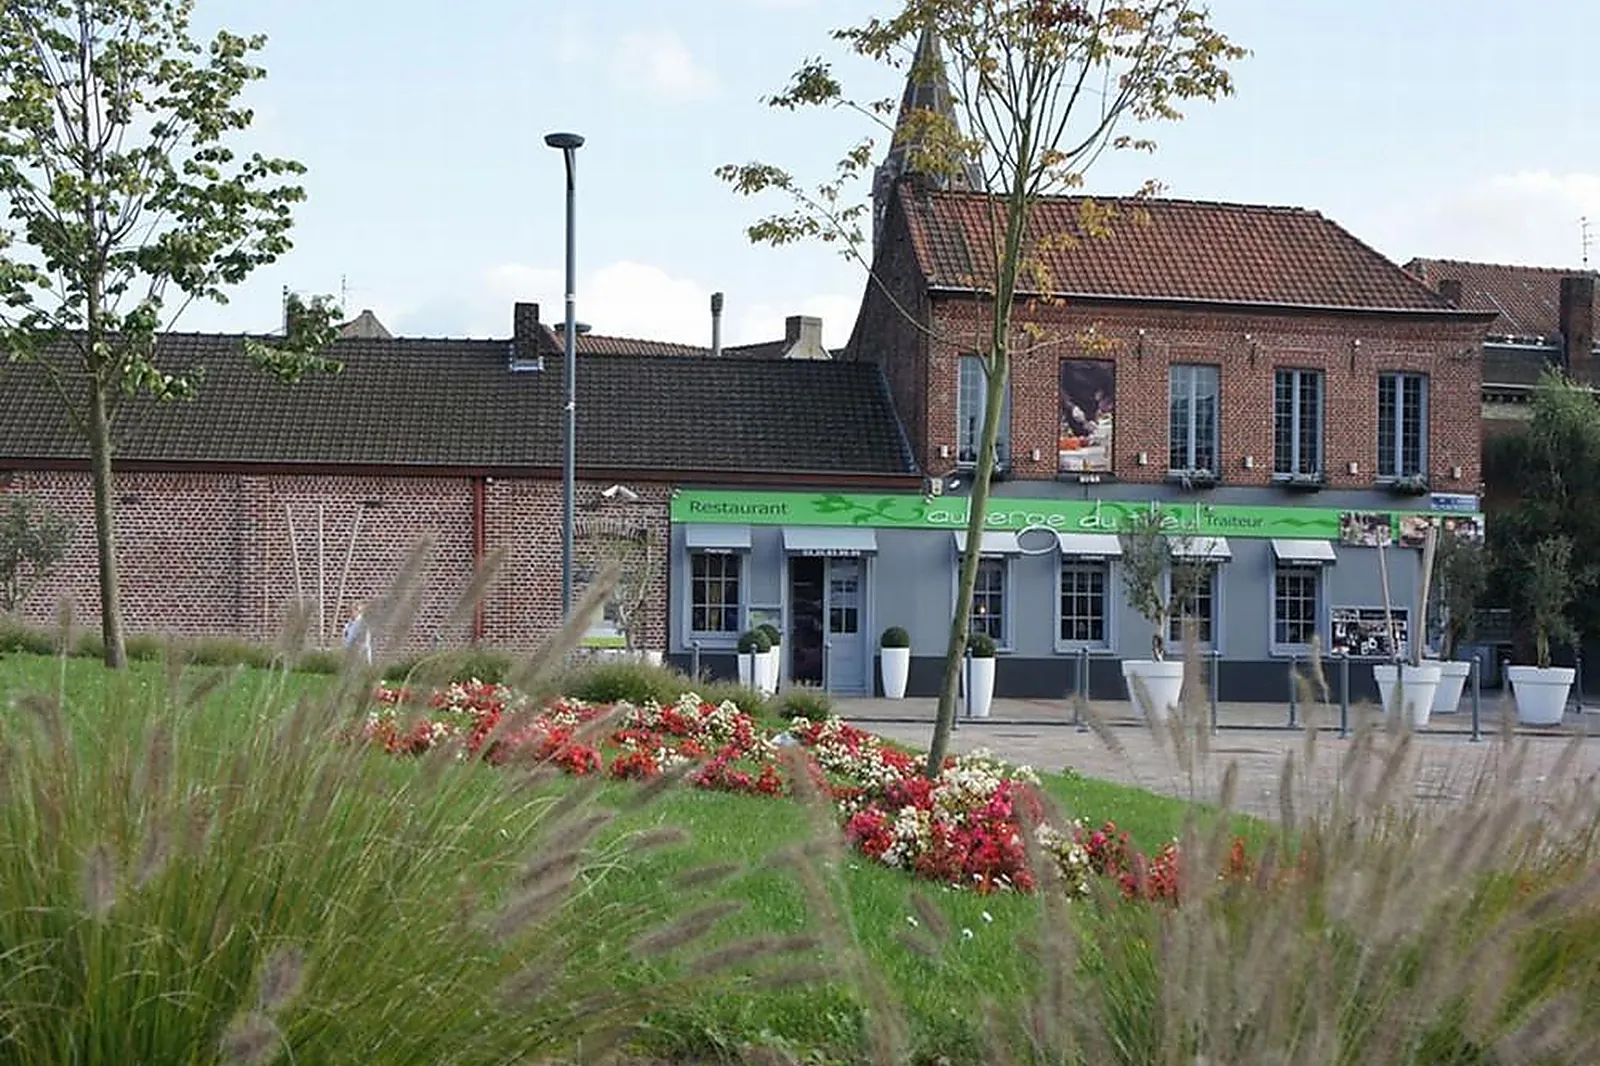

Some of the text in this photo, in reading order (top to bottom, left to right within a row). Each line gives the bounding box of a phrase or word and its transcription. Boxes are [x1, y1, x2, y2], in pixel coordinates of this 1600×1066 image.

[689, 500, 789, 515] Restaurant
[1079, 498, 1116, 528] du
[1204, 513, 1264, 528] Traiteur
